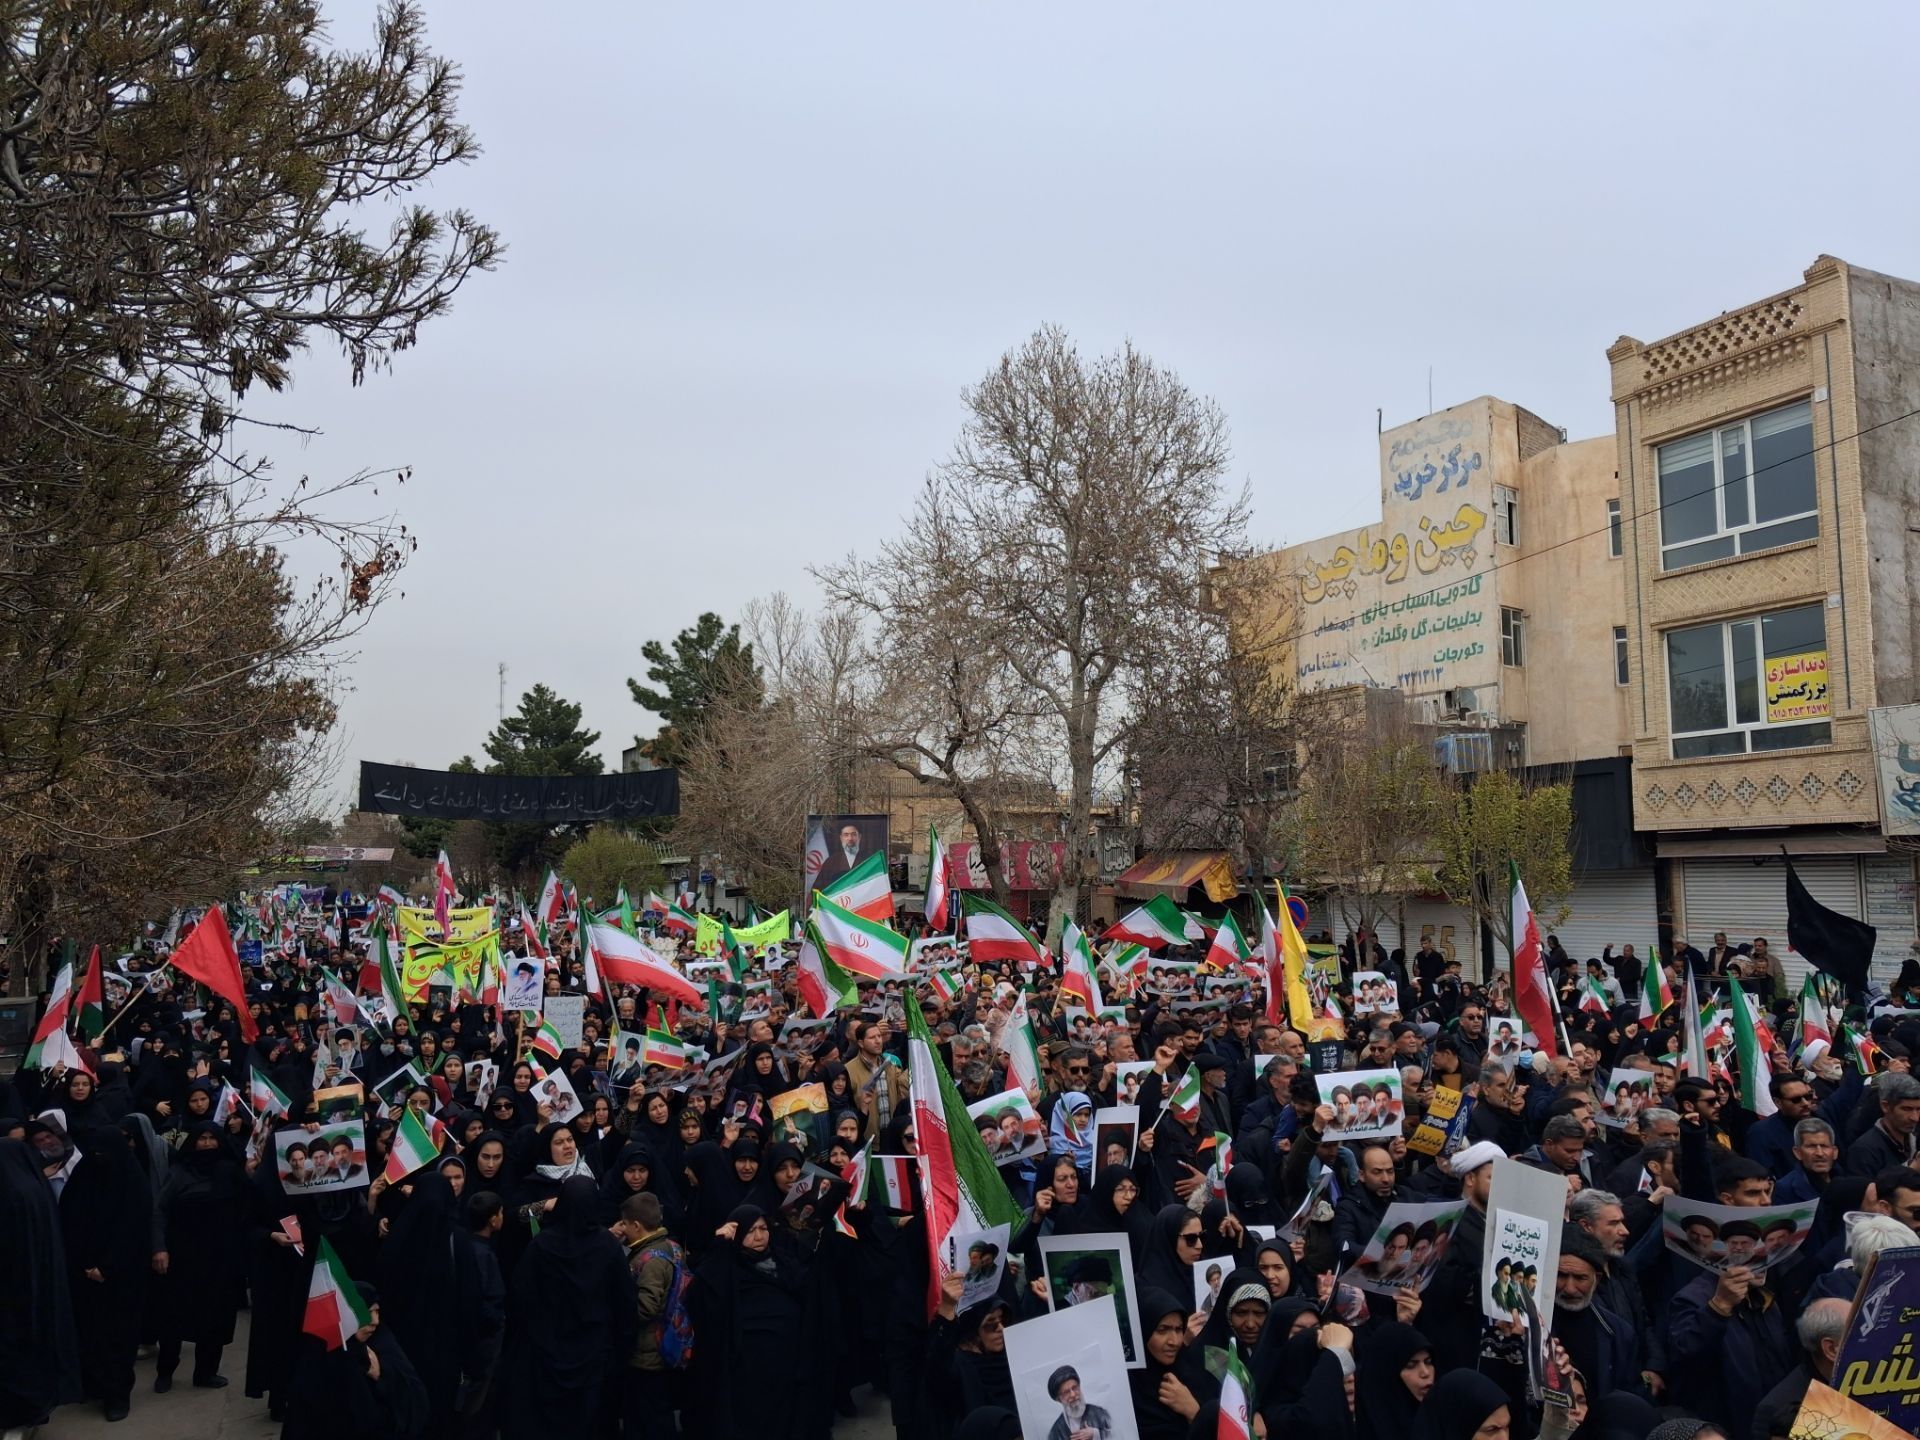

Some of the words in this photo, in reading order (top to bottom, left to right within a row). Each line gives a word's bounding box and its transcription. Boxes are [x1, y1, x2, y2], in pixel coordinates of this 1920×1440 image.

[1394, 453, 1437, 502] خرید
[1436, 443, 1482, 493] مرکز
[1415, 504, 1487, 574] چین
[1768, 657, 1825, 681] دندانسازی
